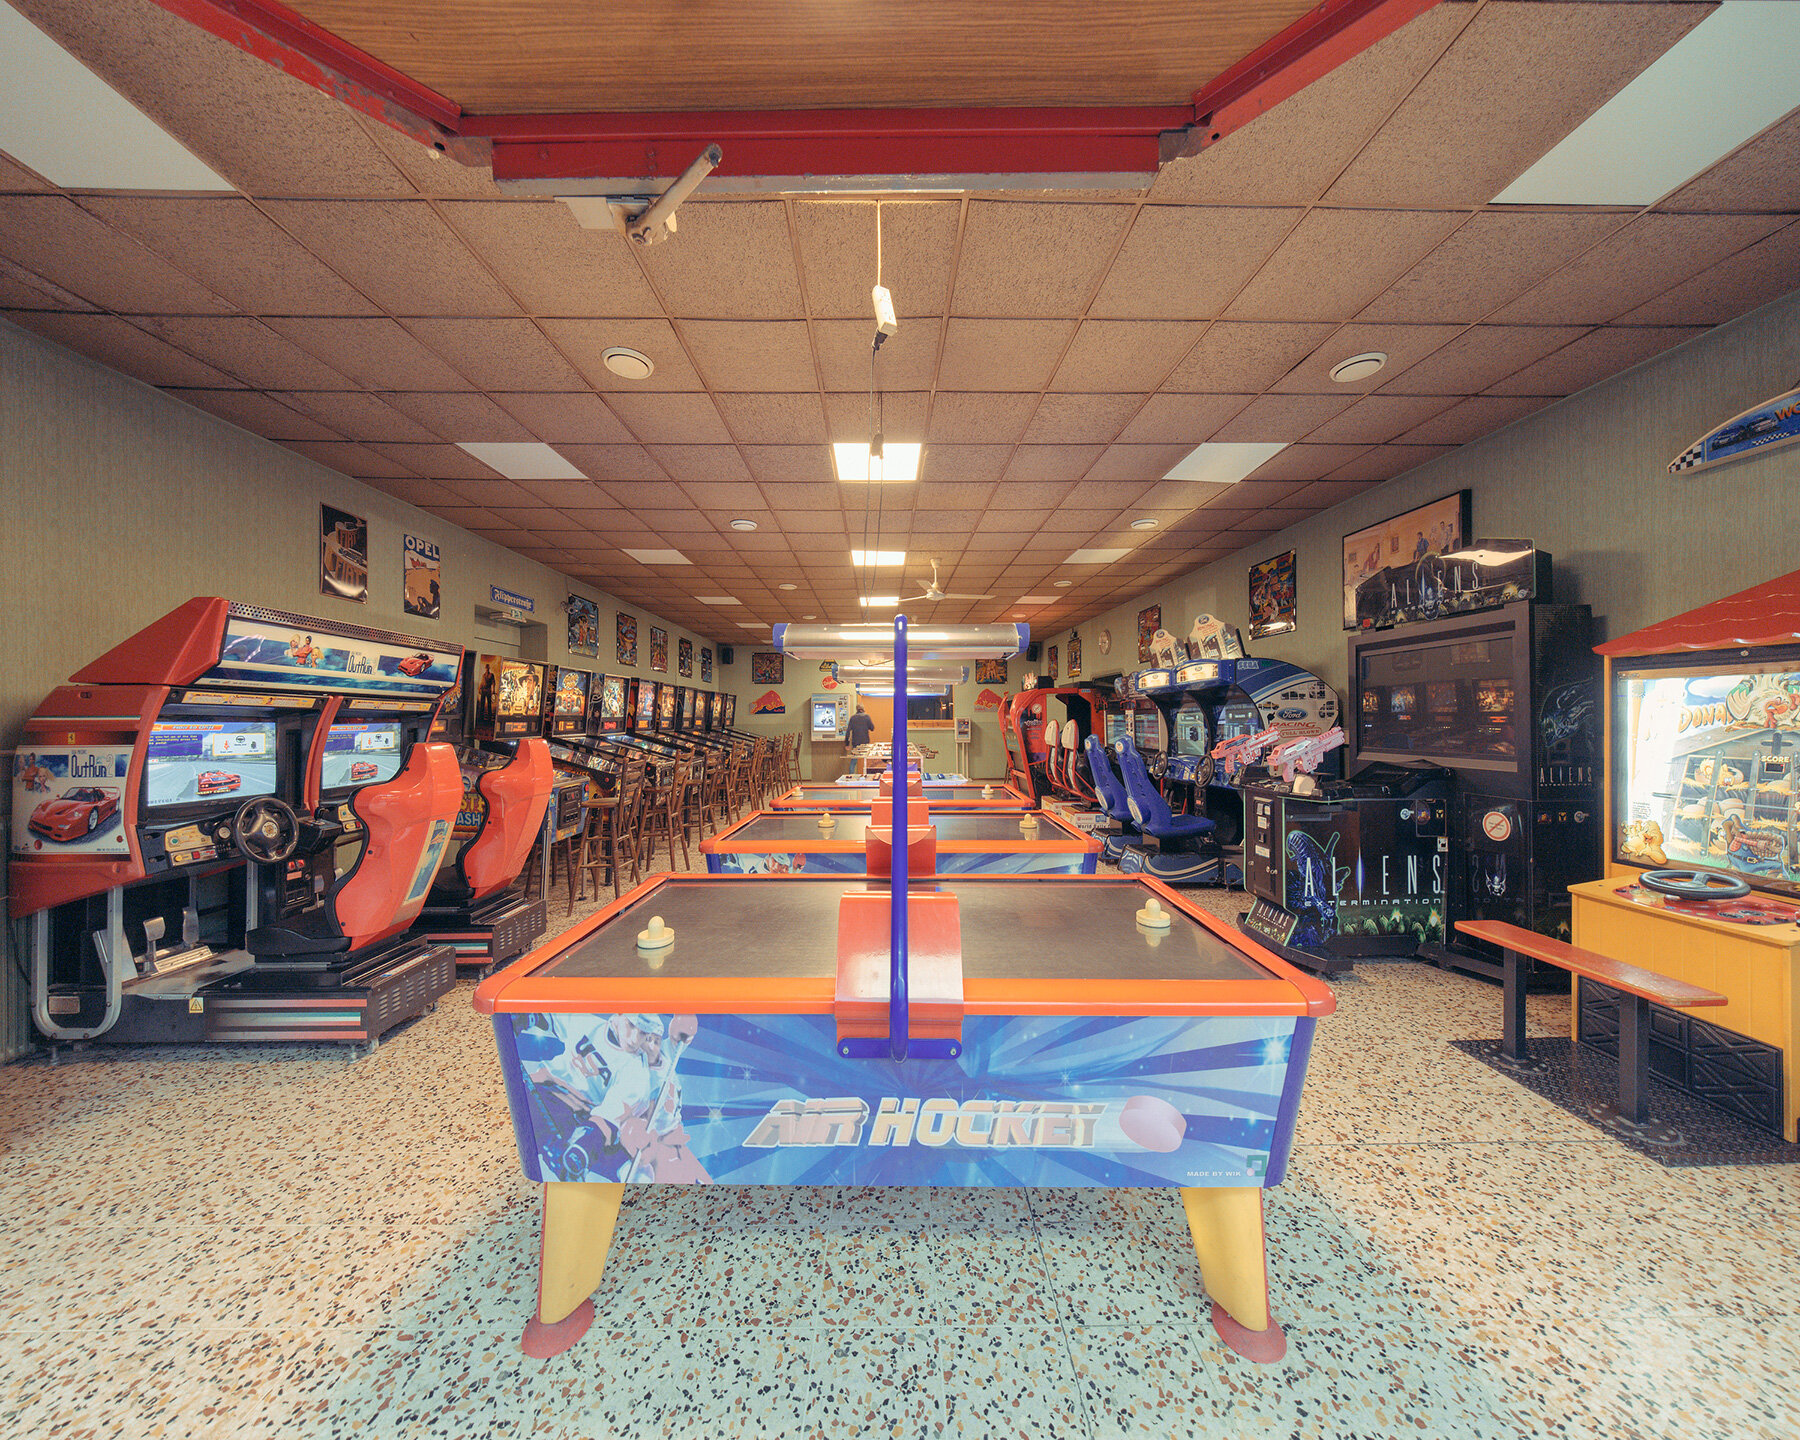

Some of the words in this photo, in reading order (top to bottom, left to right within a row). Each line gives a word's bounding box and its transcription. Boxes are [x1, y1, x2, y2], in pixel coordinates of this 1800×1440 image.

[405, 535, 440, 559] OPEL
[1282, 709, 1302, 719] Ford
[1761, 755, 1790, 763] SCORE
[1540, 766, 1592, 783] ALIENS
[456, 811, 481, 827] ASH
[1304, 853, 1442, 898] ALIENS
[1304, 898, 1441, 906] EXTERMINATION
[742, 1096, 870, 1148] AIR
[868, 1097, 1109, 1148] HOCKEY
